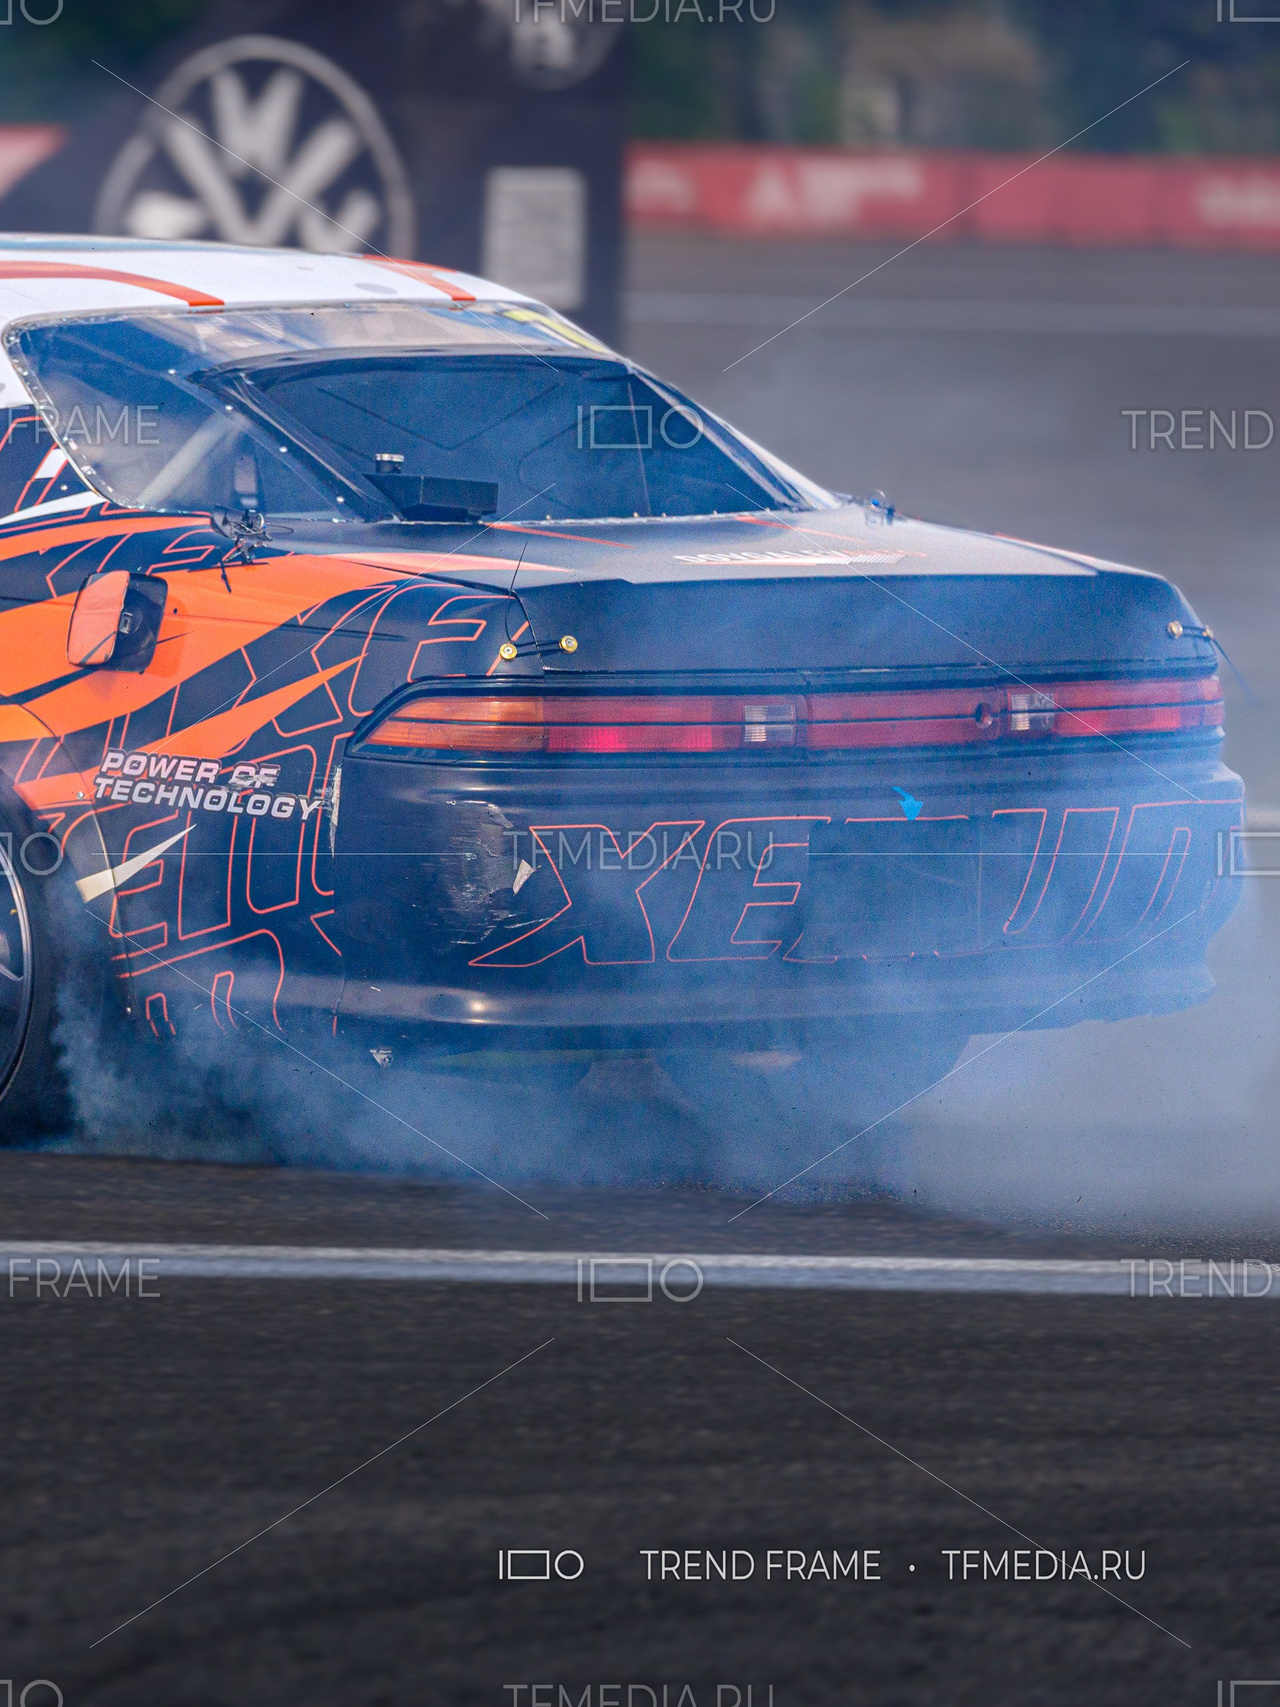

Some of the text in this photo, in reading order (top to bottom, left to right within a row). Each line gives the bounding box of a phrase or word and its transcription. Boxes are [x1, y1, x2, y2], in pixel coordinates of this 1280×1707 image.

[100, 749, 281, 789] POWER OF
[94, 777, 322, 821] TECHNOLOGY
